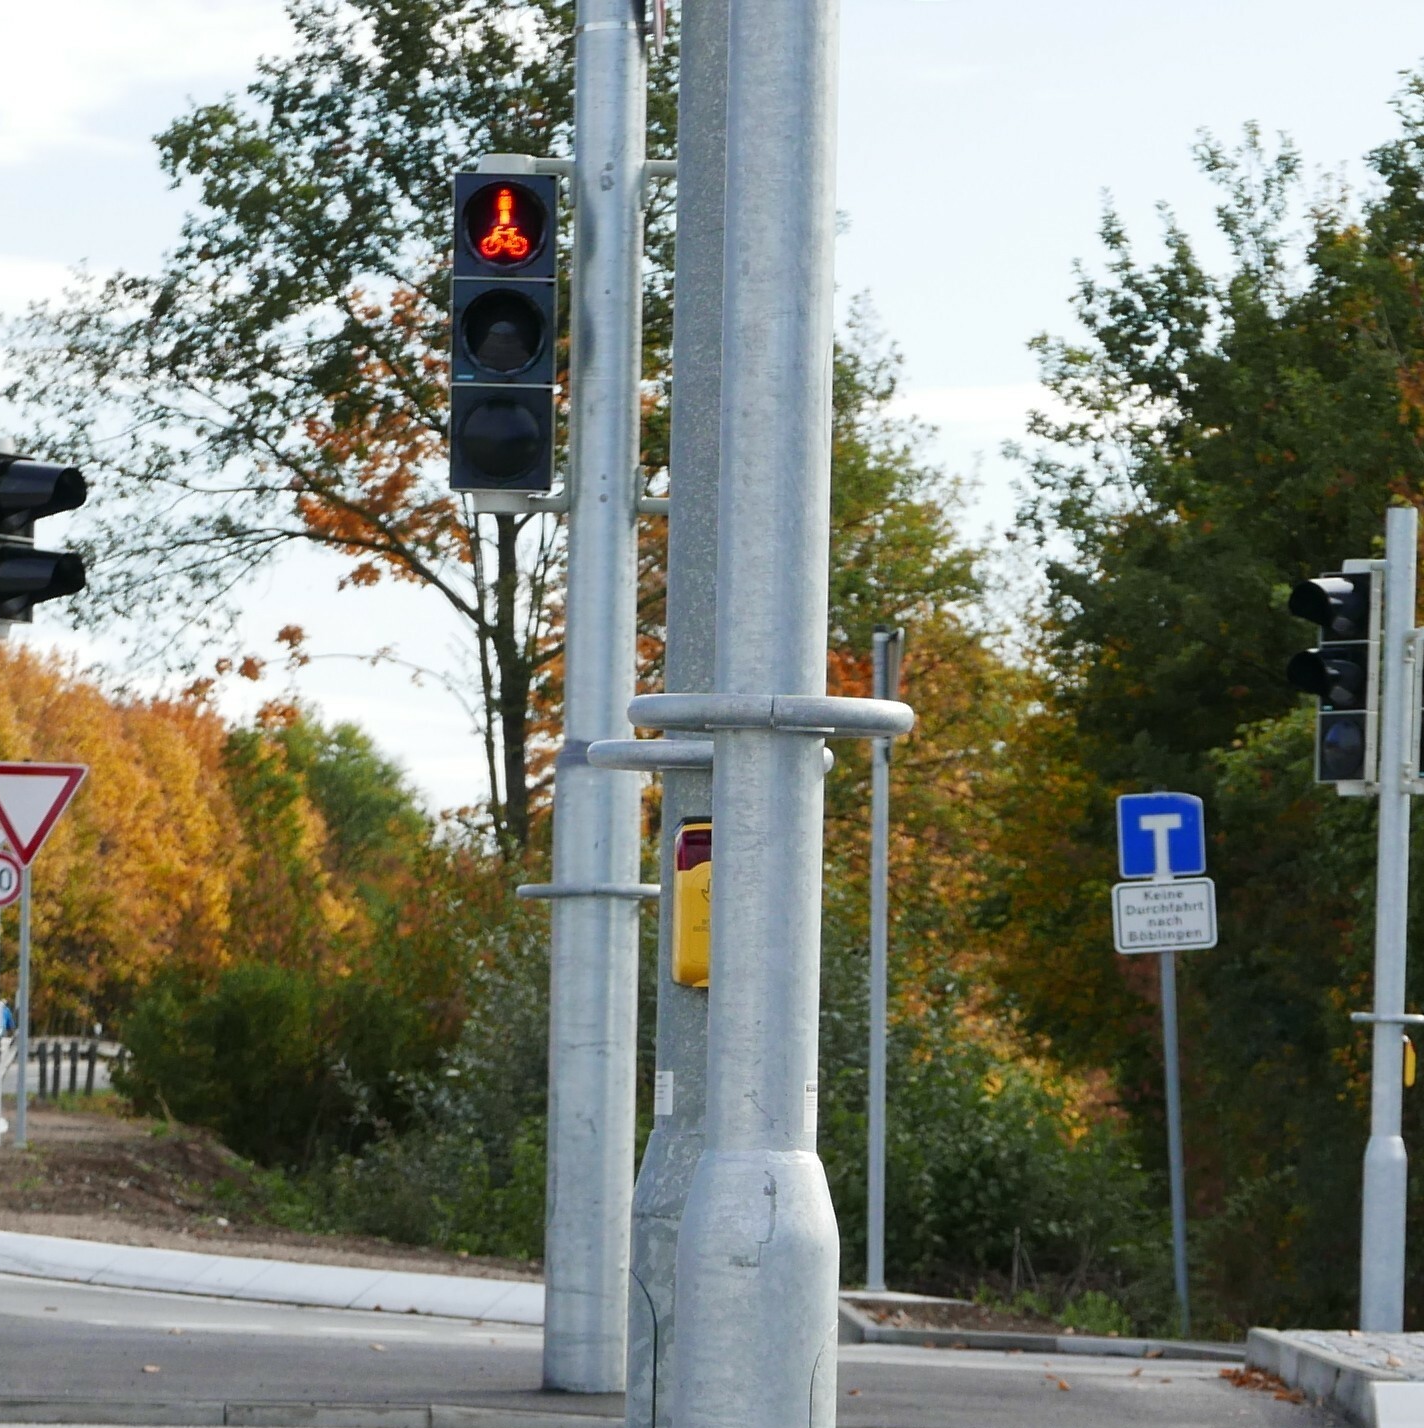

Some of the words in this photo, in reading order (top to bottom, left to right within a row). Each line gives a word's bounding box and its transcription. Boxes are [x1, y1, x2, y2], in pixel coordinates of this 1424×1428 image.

[1143, 890, 1184, 901] Keine
[1125, 901, 1204, 916] Durchfahrt
[1149, 915, 1183, 927] nach
[1128, 929, 1202, 943] Böblingen
